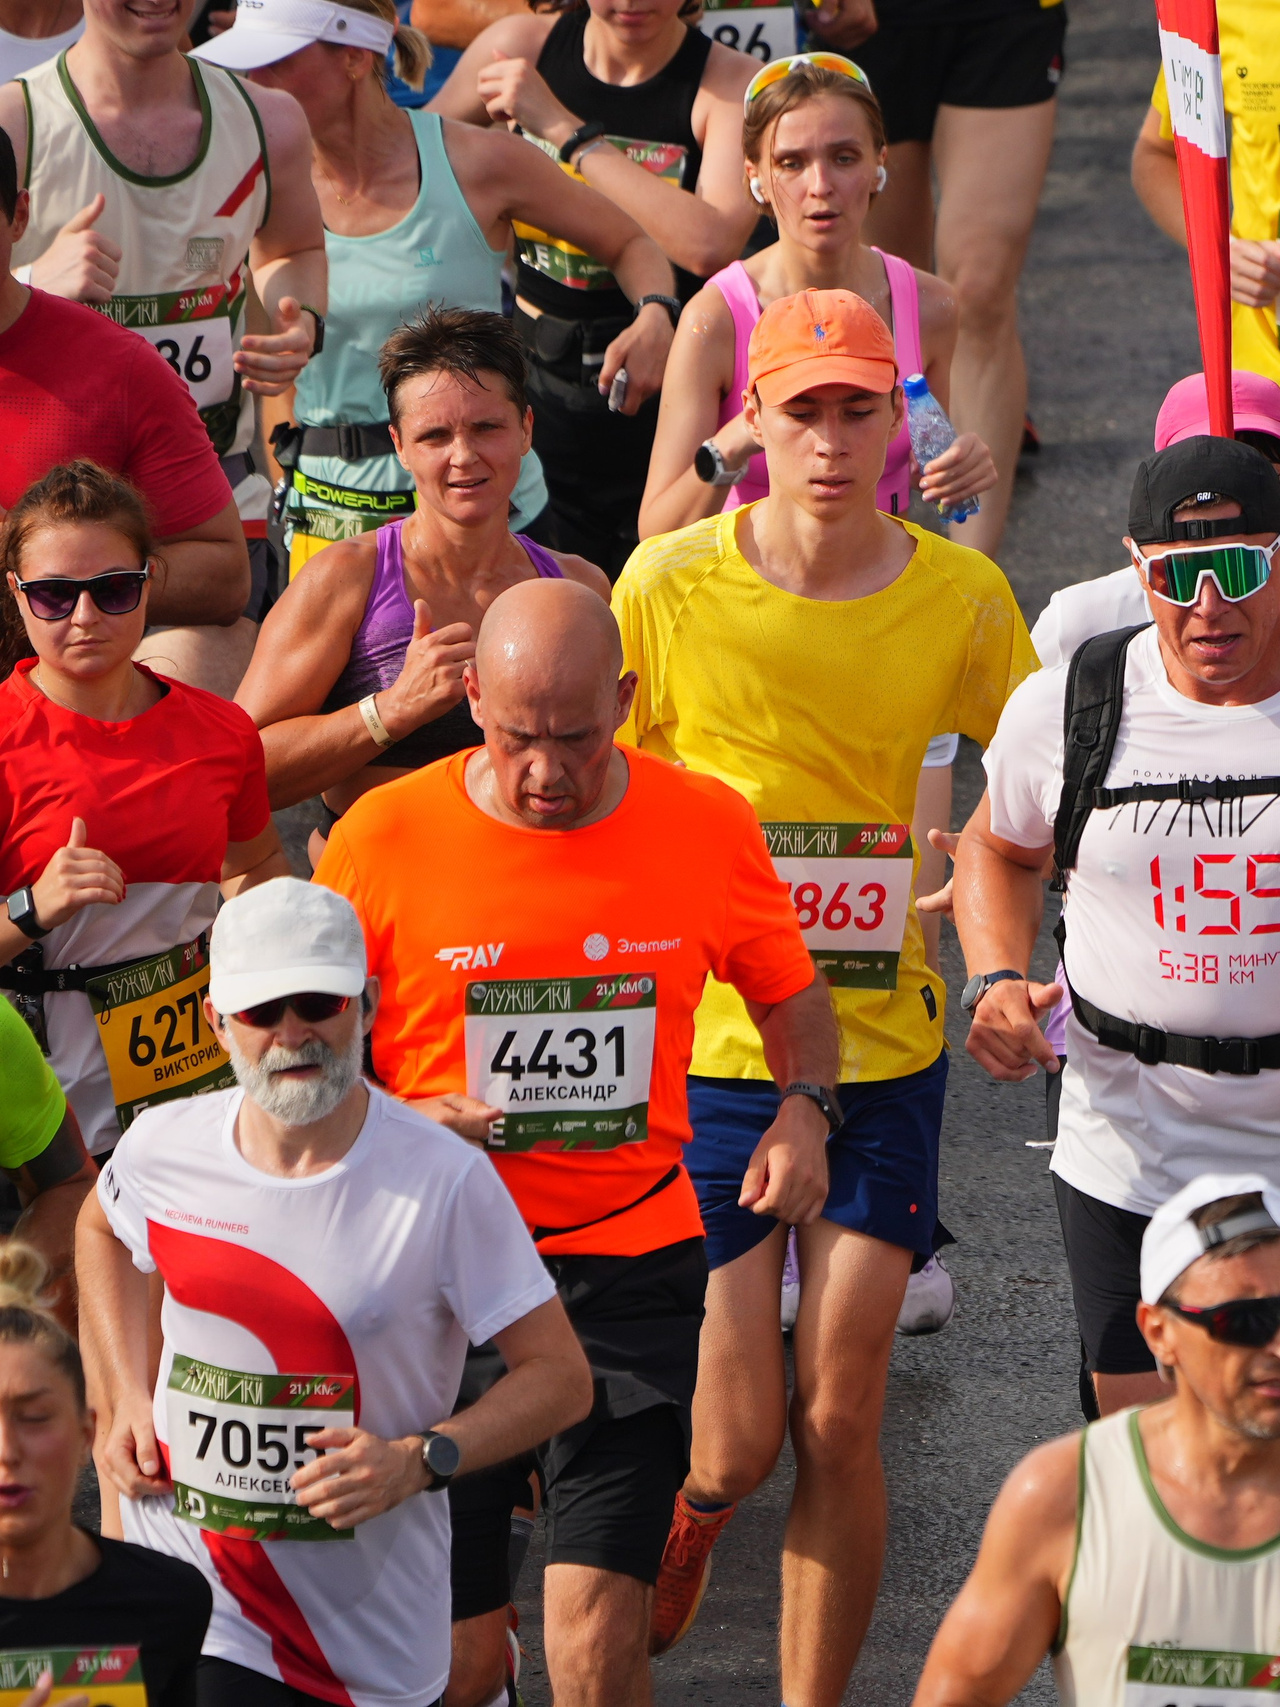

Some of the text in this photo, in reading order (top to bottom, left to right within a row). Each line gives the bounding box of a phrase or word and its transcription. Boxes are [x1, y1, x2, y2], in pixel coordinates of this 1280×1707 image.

[179, 297, 196, 309] 21,1
[305, 481, 407, 510] POWERUP
[1132, 769, 1257, 781] ПОЛУМАРАФОН
[861, 831, 878, 843] 21,1
[881, 832, 898, 843] КМ
[787, 882, 887, 931] 863
[435, 943, 504, 971] RAY
[617, 938, 682, 953] Элемент
[1159, 949, 1219, 984] 5:38
[1229, 971, 1255, 984] КМ
[107, 959, 175, 1004] ЛУЖНИКИ
[481, 981, 638, 1012] ЛУЖНИКИ 21,1 КМ
[154, 1042, 221, 1082] ВИКТОРИЯ
[490, 1025, 625, 1081] 4431
[509, 1084, 617, 1101] АЛЕКСАНДР
[165, 1208, 249, 1235] NECHAEVA RUNNERS
[289, 1384, 310, 1395] 21,1
[189, 1410, 326, 1474] 7055
[188, 1490, 207, 1520] D
